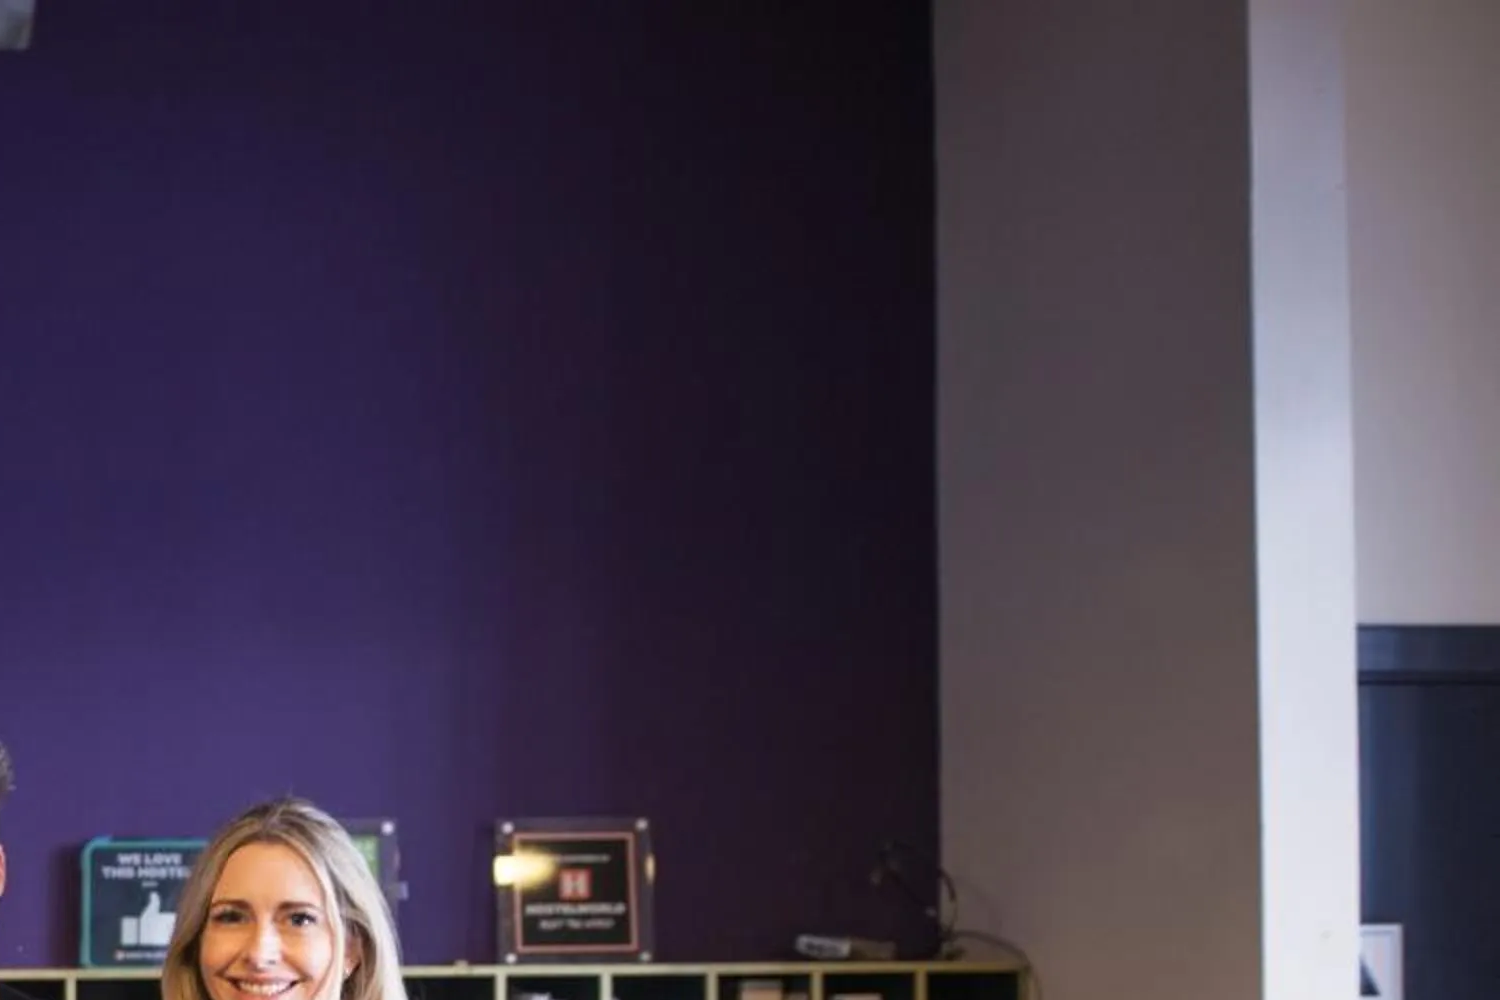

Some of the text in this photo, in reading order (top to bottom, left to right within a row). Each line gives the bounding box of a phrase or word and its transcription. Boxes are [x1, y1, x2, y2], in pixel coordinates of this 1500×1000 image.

[117, 853, 182, 865] WE LOVE
[102, 866, 135, 879] THIS
